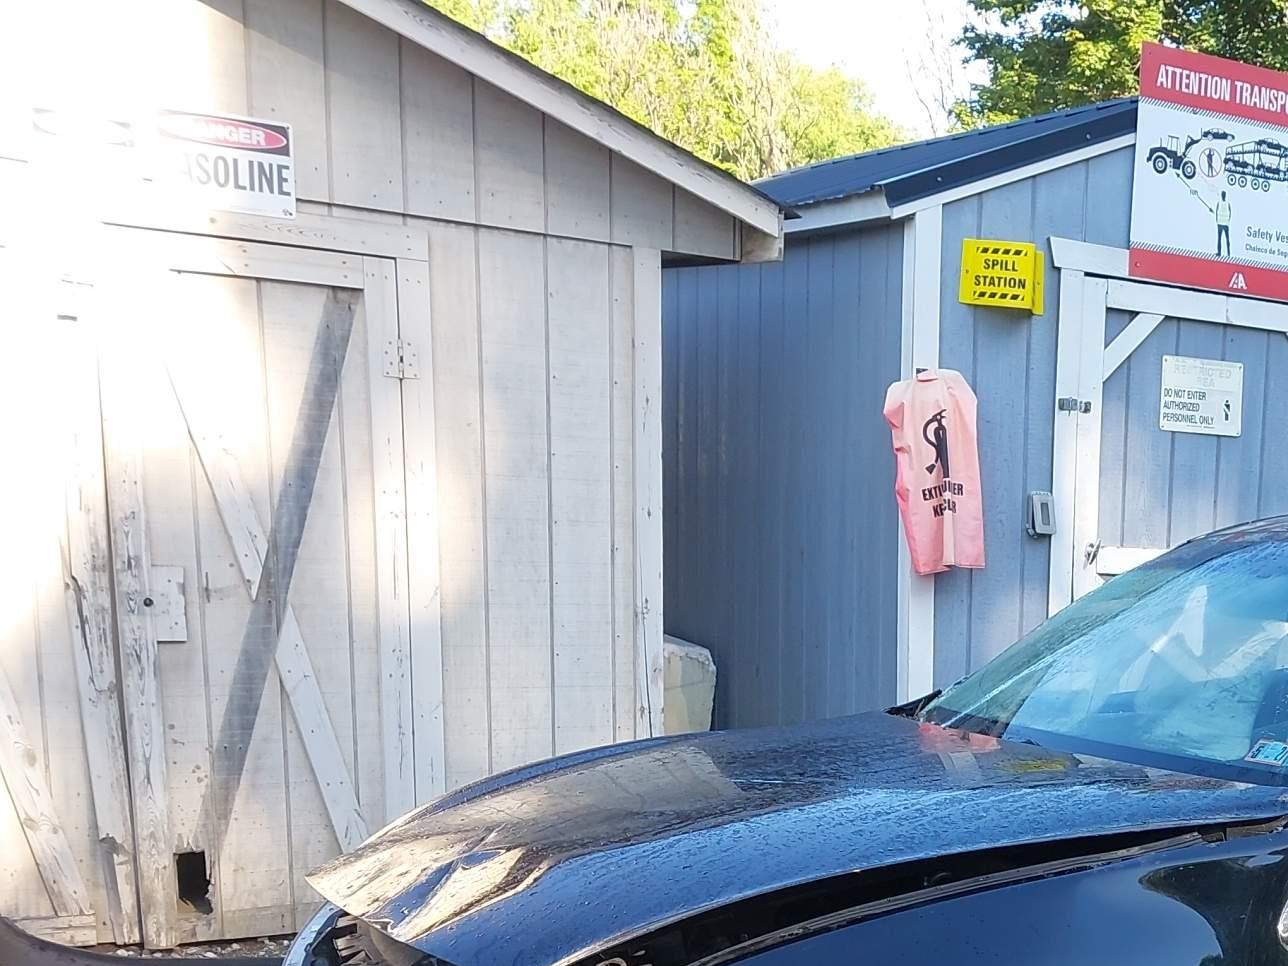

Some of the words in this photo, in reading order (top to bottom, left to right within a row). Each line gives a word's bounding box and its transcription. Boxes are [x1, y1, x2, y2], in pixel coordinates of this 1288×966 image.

[1156, 64, 1230, 102] ATTENTION
[182, 152, 291, 197] ASOLINE
[1246, 226, 1273, 243] Safety
[983, 257, 1018, 273] SPILL
[974, 274, 1027, 291] STATION
[1163, 388, 1173, 398] DO
[1174, 389, 1186, 399] NOT
[1187, 390, 1207, 400] ENTER
[1163, 400, 1200, 412] AUTHORIZED
[1162, 412, 1198, 425] PERSONNEL
[1199, 415, 1215, 425] ONLY
